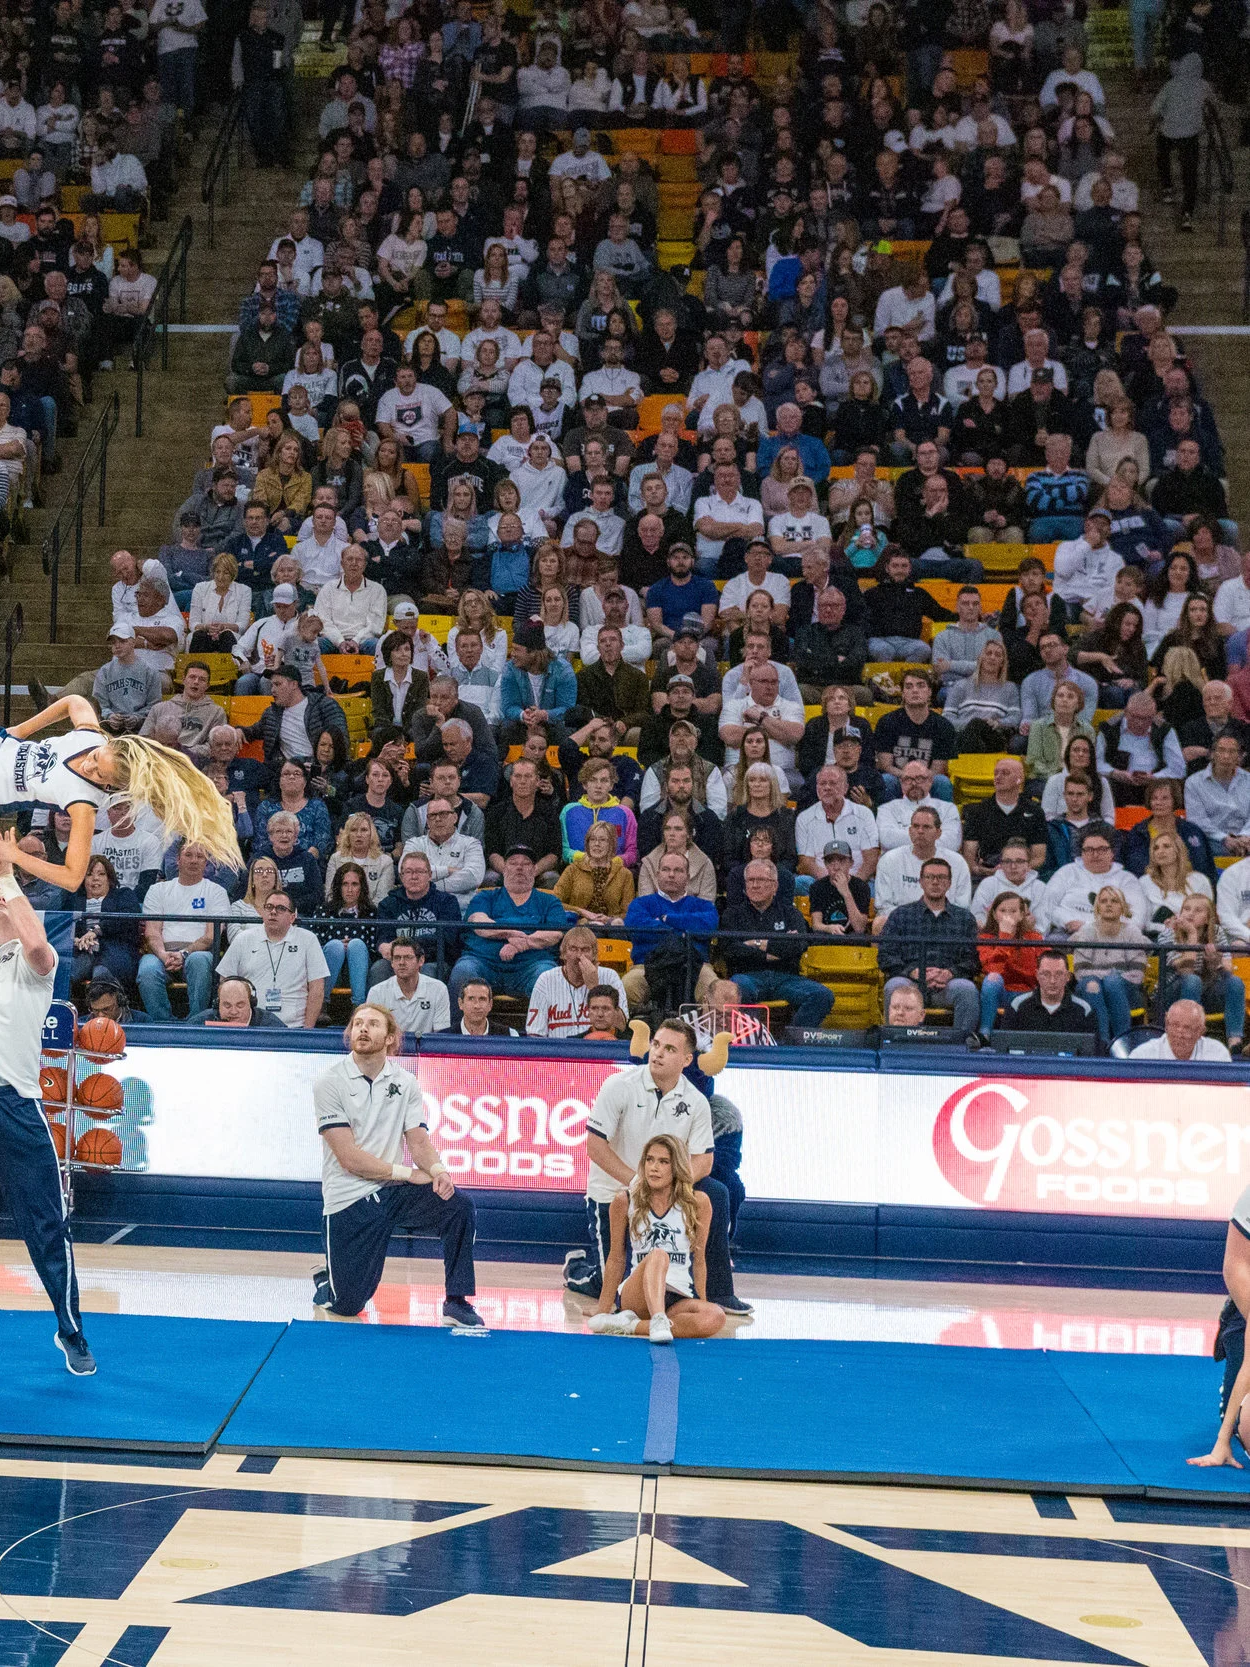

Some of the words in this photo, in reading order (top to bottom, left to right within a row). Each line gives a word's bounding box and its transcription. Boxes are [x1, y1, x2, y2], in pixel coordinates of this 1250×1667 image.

[107, 681, 125, 693] UTAH
[126, 678, 144, 693] STATE
[893, 746, 931, 760] STATE
[14, 762, 28, 792] STATE
[527, 1008, 539, 1026] 7
[547, 1003, 573, 1021] Mud
[950, 1083, 1250, 1202] Gossner
[438, 1148, 576, 1179] OODS
[1036, 1173, 1211, 1206] FOODS
